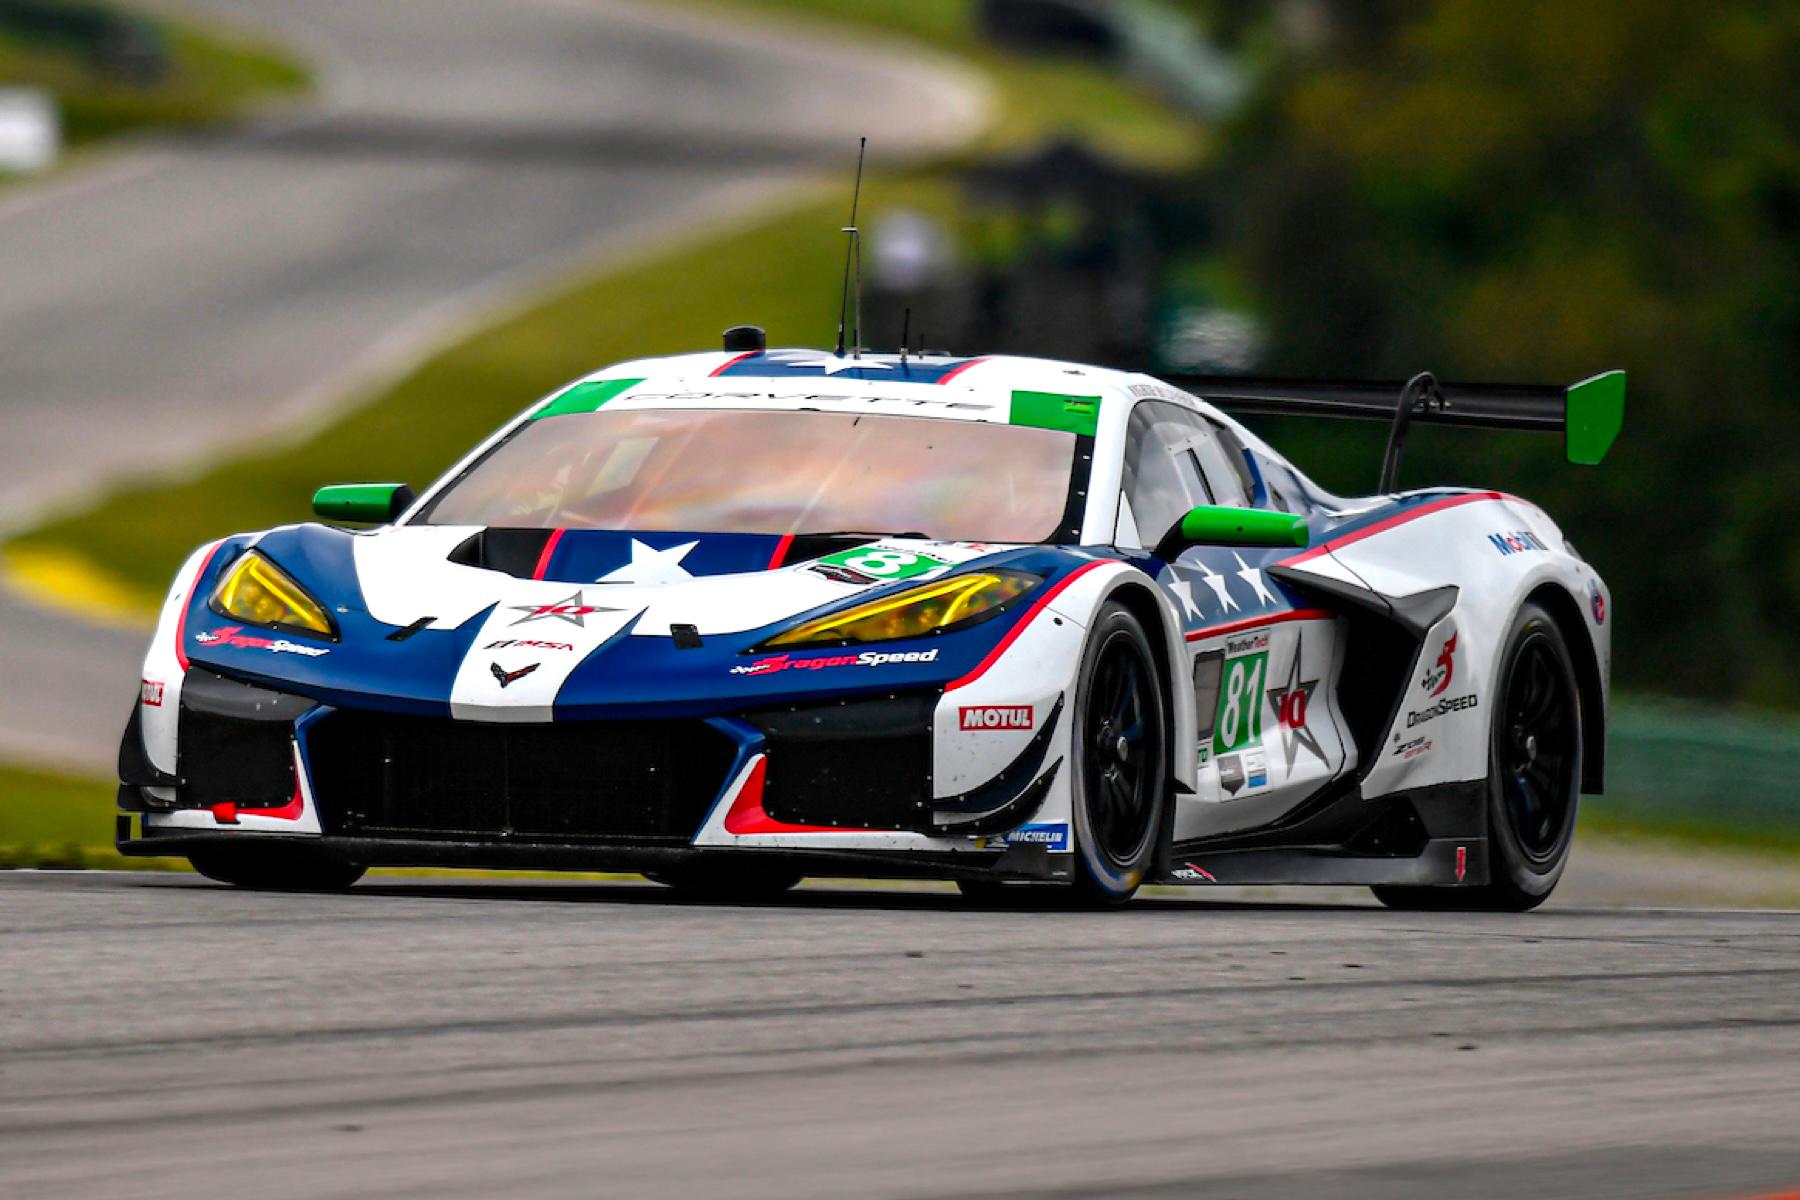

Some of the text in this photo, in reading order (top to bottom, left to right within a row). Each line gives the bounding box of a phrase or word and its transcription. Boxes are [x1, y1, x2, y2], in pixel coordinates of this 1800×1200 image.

[624, 392, 995, 411] CORVETTE
[1228, 635, 1268, 654] WeatherTech
[1221, 658, 1263, 748] 81
[963, 708, 1031, 727] MOTUL
[1006, 830, 1064, 842] MICHELIN
